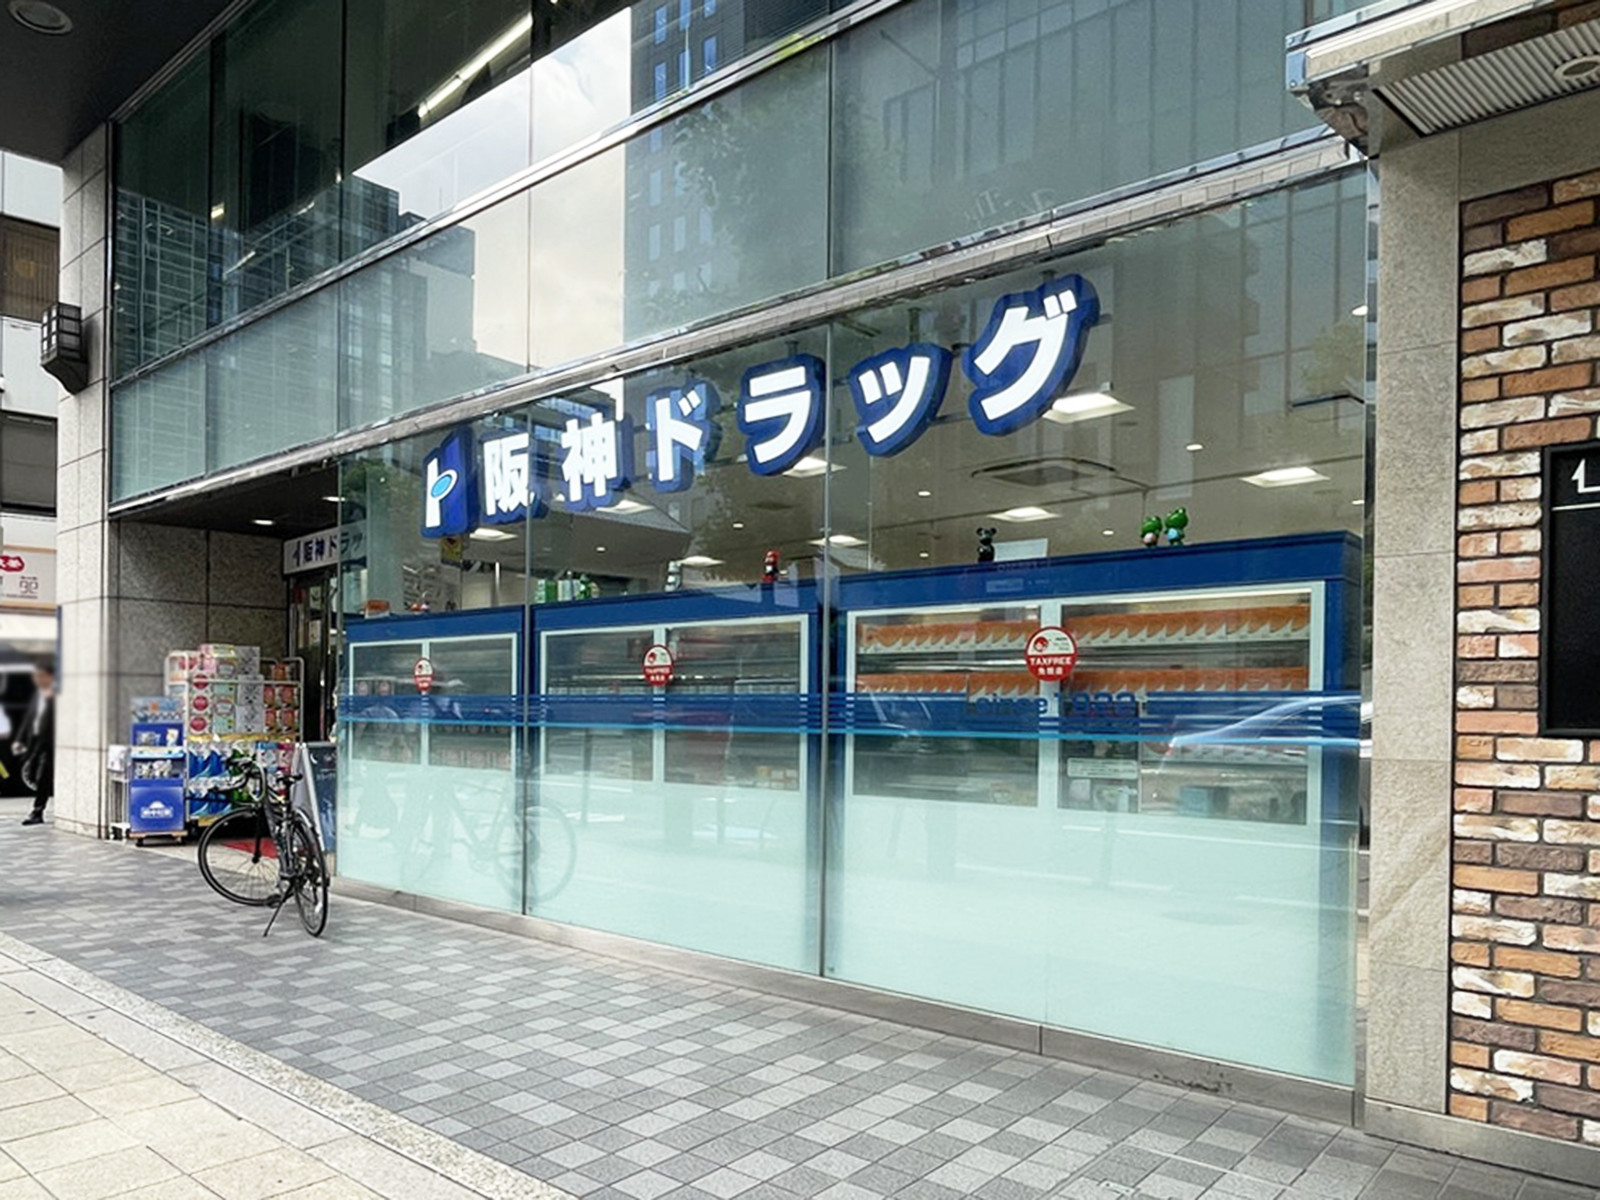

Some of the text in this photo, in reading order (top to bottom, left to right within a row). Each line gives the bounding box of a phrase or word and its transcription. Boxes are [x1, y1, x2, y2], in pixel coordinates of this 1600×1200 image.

[482, 288, 1079, 516] 阪神ドラッグ
[303, 532, 367, 562] 阪神ドラッ
[1030, 656, 1072, 665] TAXFREE
